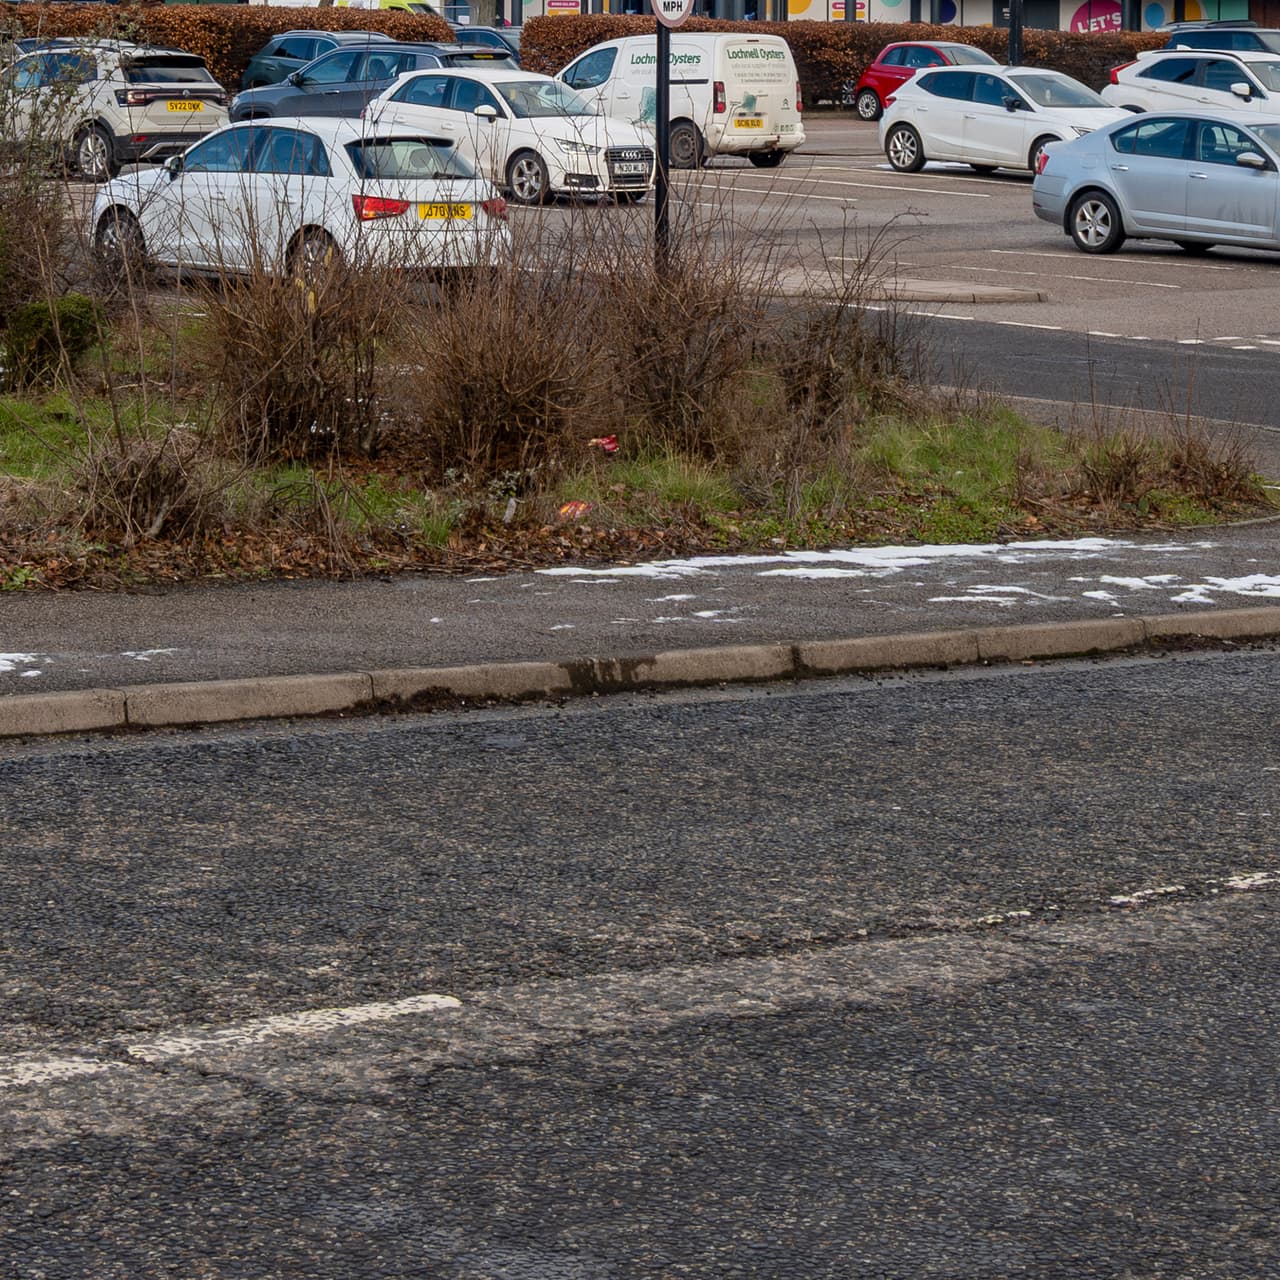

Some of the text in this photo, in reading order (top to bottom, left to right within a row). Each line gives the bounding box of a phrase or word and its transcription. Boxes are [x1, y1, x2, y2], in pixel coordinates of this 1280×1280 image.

[663, 1, 683, 12] MPH
[1077, 12, 1122, 33] LET'S
[727, 48, 785, 61] Lochnell Oysters
